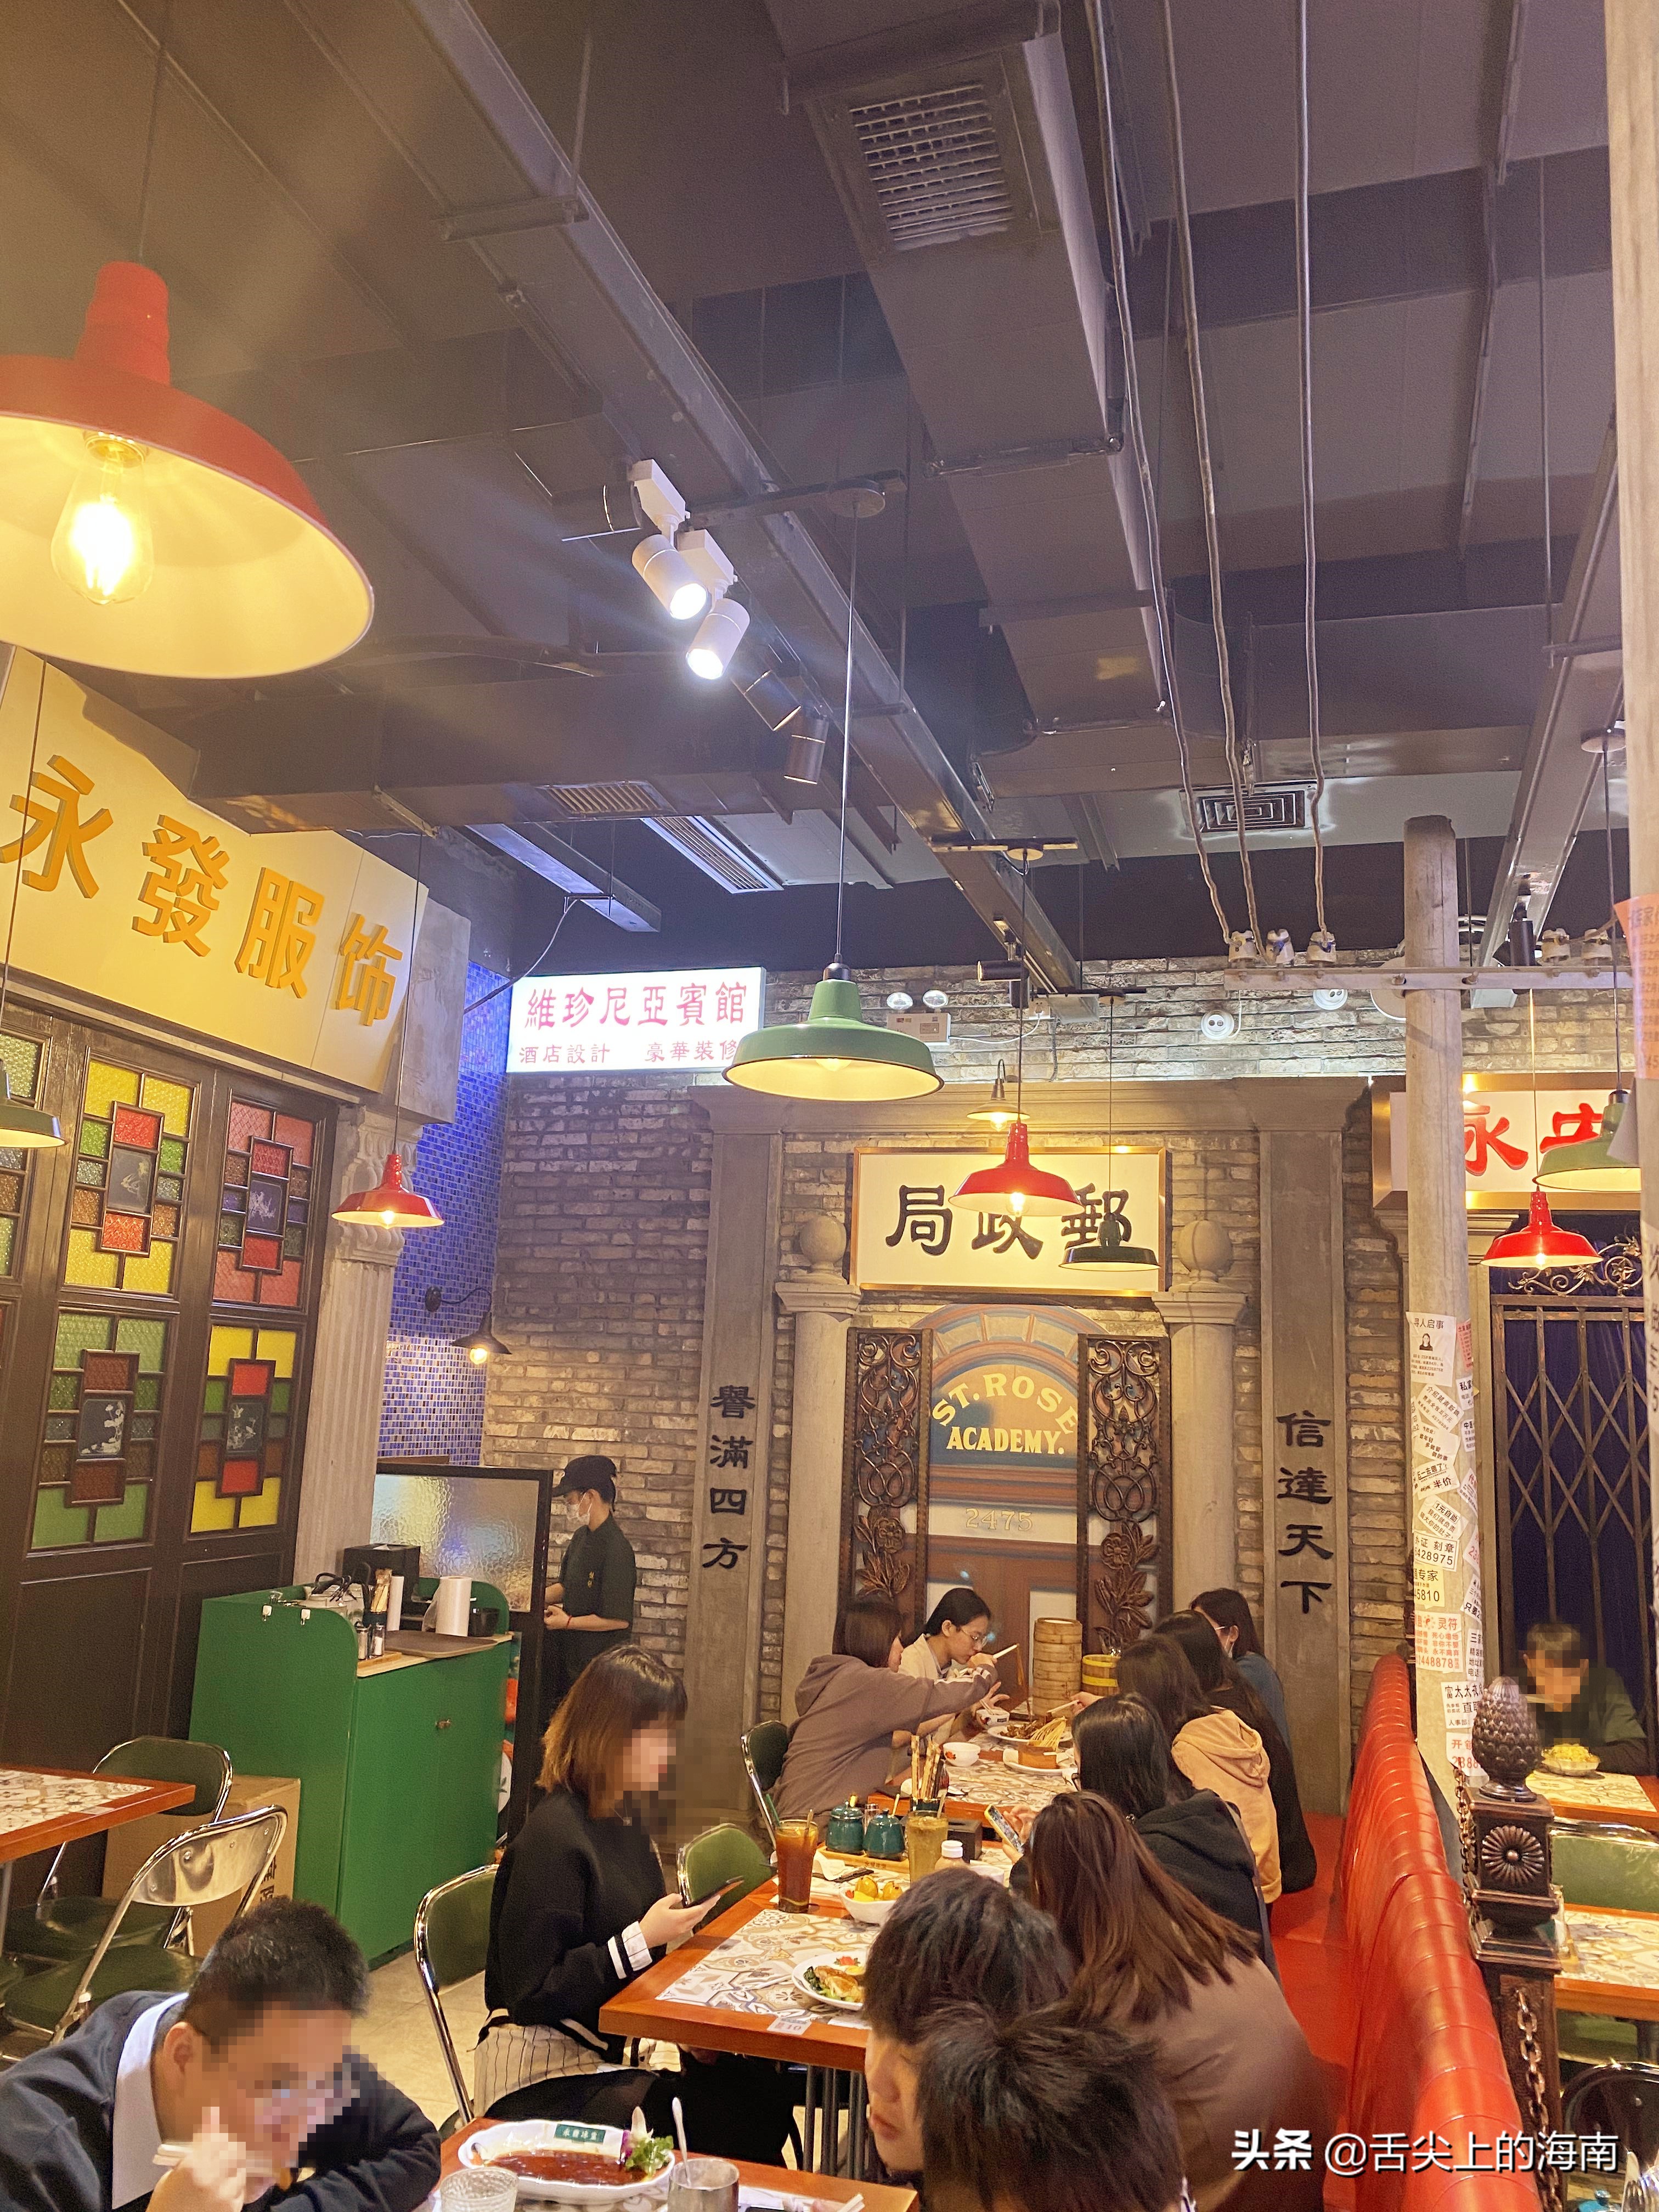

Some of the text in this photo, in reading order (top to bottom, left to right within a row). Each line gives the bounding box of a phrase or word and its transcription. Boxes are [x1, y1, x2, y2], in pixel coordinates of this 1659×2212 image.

[0, 755, 403, 1027] 永發服饰
[524, 981, 747, 1030] 維珍尼亞賓館
[518, 1043, 611, 1063] 酒店設計
[1414, 1318, 1444, 1329] 寻人启事
[932, 1372, 1078, 1435] ST. ROSE
[946, 1426, 1065, 1455] ACADEMY.
[702, 1385, 756, 1570] 譽滿四方
[1433, 1477, 1451, 1488] 半价
[965, 1508, 1032, 1532] 2475
[1275, 1409, 1334, 1614] 信達天下
[1435, 1503, 1458, 1522] 1元自助
[1434, 1541, 1454, 1553] 刻章
[1438, 1617, 1458, 1630] 灵符
